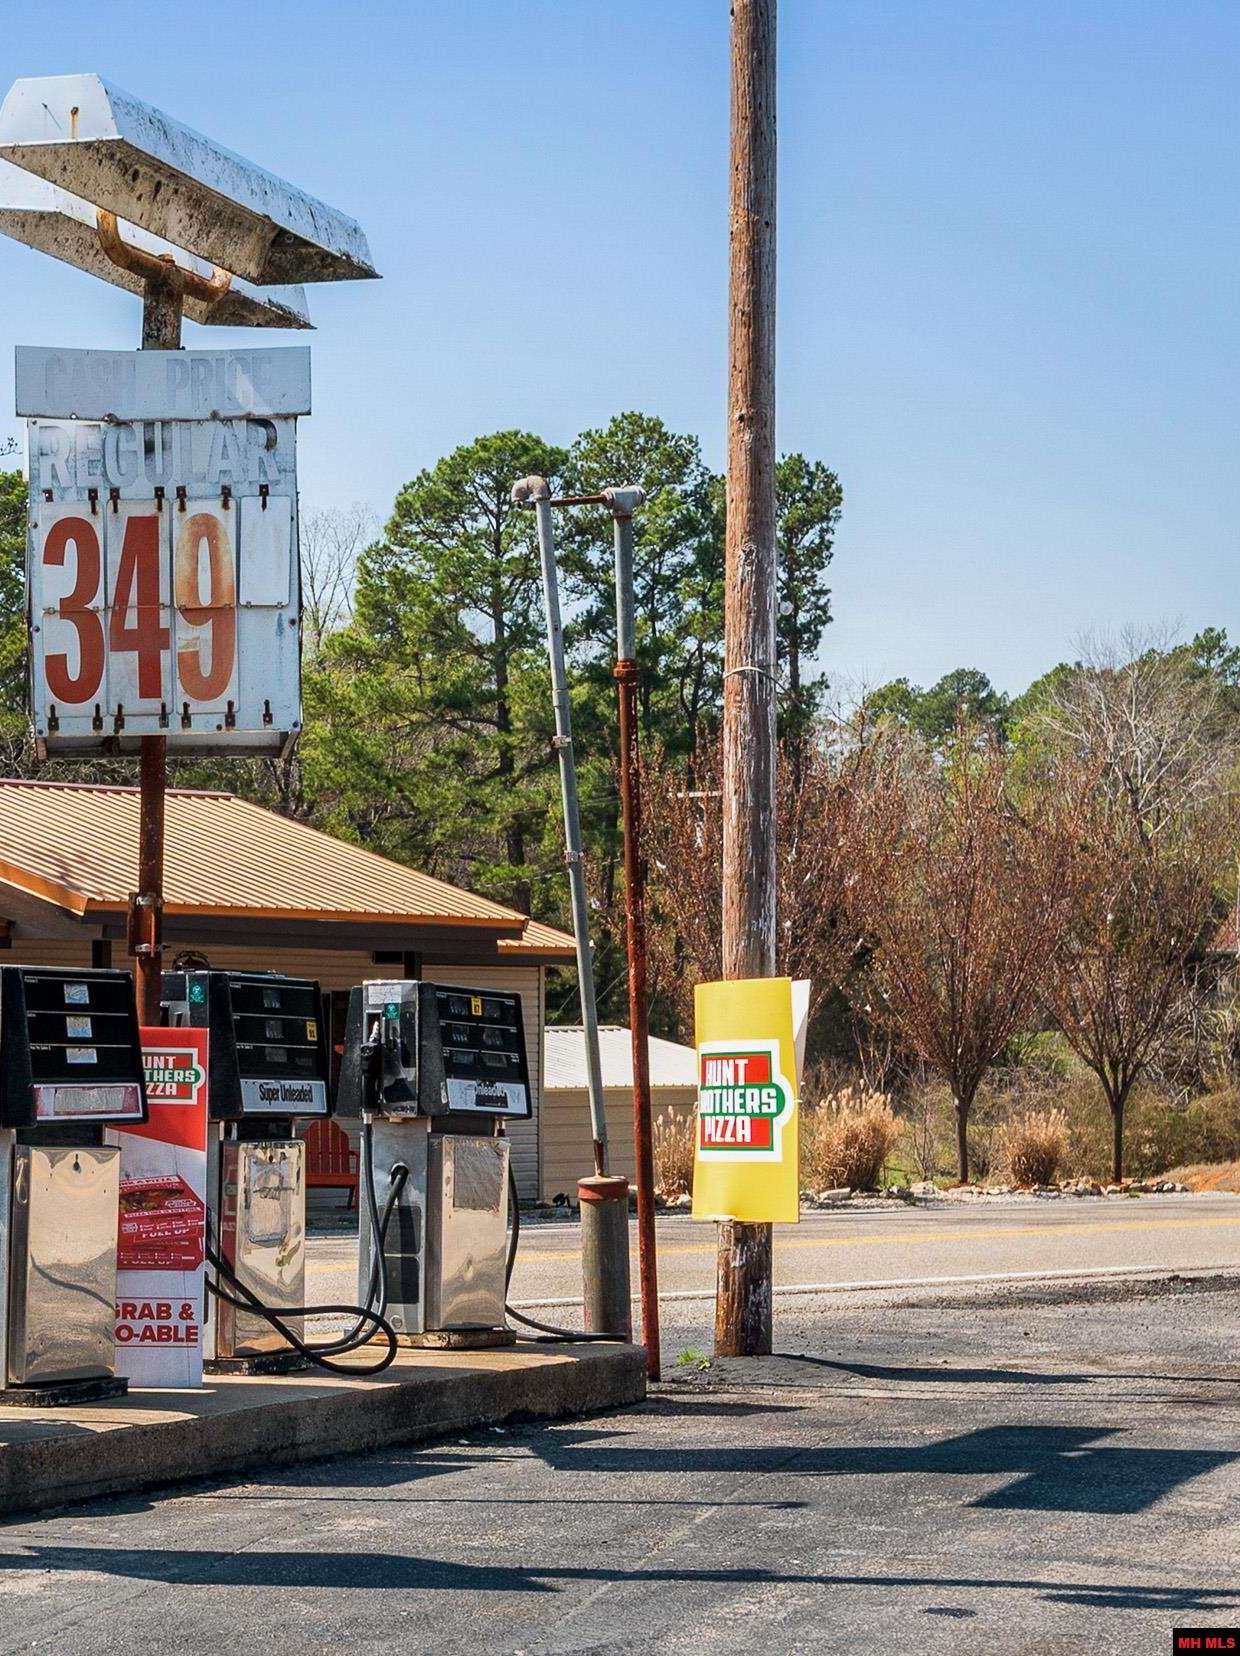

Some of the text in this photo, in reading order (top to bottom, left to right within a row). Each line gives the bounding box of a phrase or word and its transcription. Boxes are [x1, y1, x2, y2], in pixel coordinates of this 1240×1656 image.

[38, 418, 280, 487] REGULAR
[43, 512, 236, 704] 349
[142, 1055, 177, 1069] UNT
[143, 1069, 196, 1082] THERS
[145, 1082, 178, 1096] ZZA
[700, 1087, 777, 1114] OTHERS
[704, 1115, 752, 1143] PIZZA
[178, 1302, 196, 1320] &
[115, 1324, 198, 1342] O-ABLE
